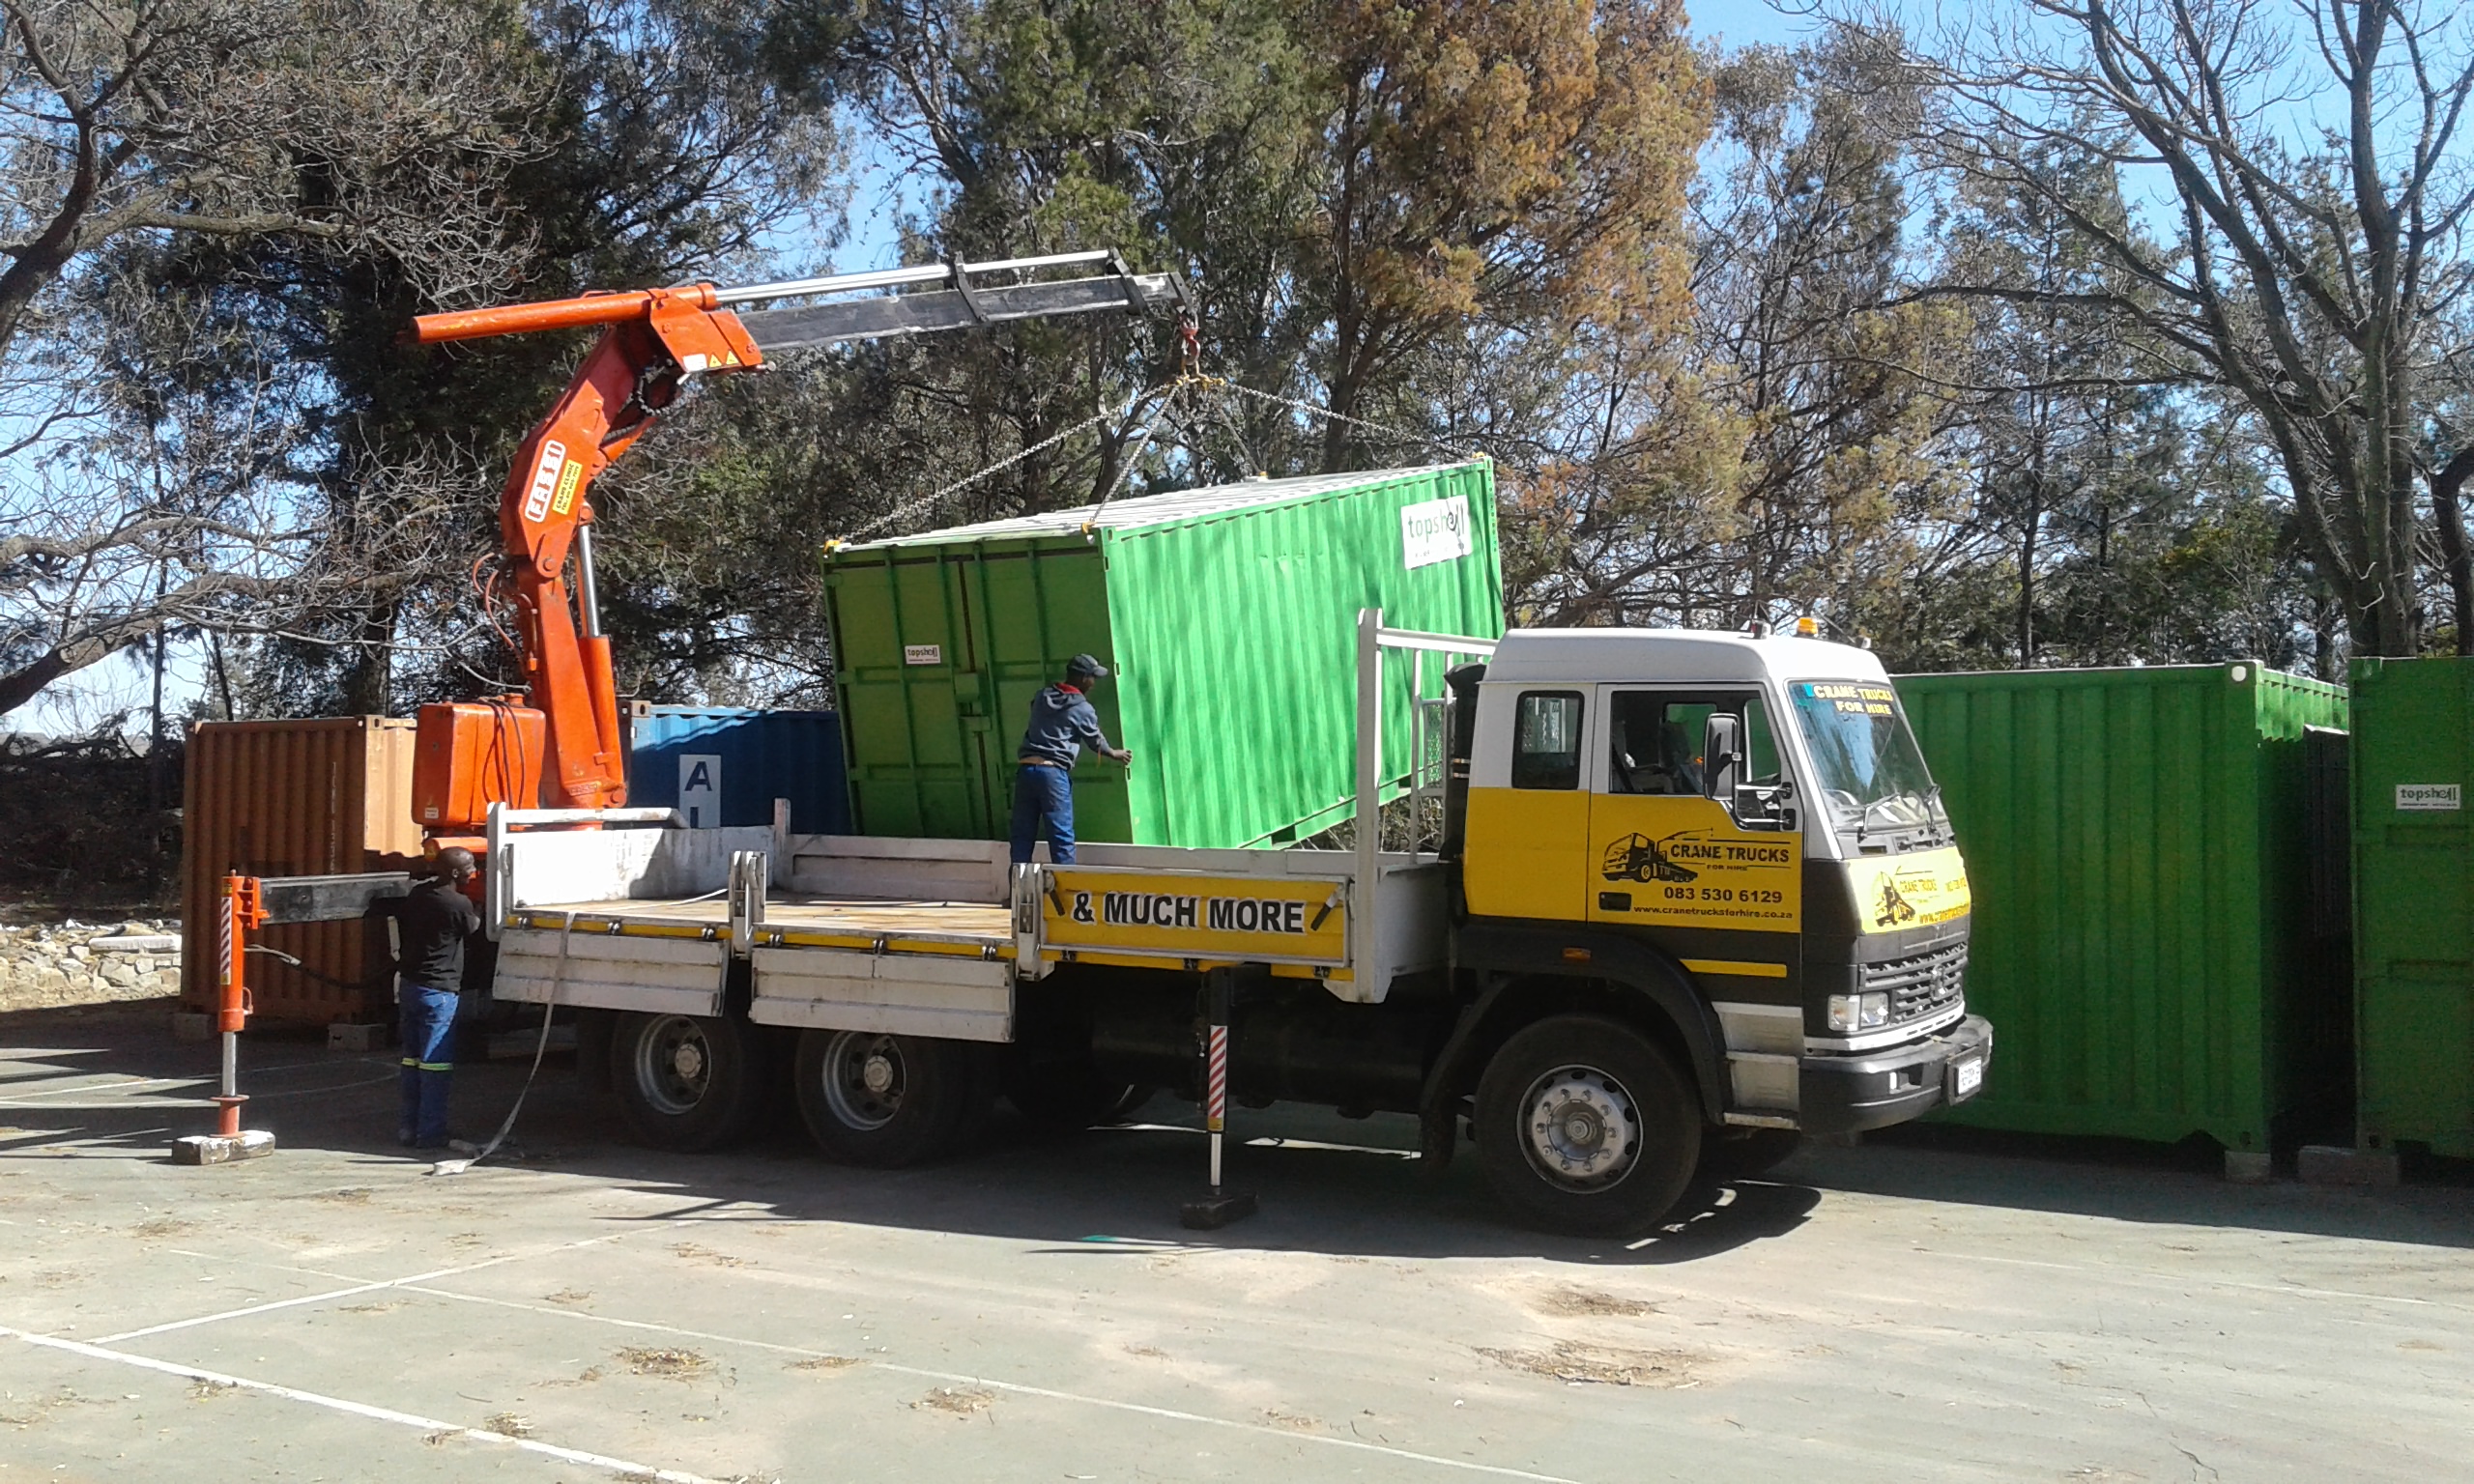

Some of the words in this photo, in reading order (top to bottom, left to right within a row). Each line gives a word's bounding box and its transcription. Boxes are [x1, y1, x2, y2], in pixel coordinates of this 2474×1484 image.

[528, 443, 563, 518] FASSI
[1408, 501, 1465, 543] topshell
[1813, 686, 1858, 699] CRANE
[1857, 689, 1893, 701] TRUCKS
[1835, 700, 1864, 712] FOR
[1865, 703, 1892, 715] HIRE
[2401, 786, 2457, 801] topshell
[1670, 843, 1721, 860] CRANE
[1727, 846, 1790, 863] TRUCKS
[1663, 886, 1695, 900] 083
[1701, 888, 1733, 901] 530
[1739, 890, 1783, 903] 6129
[1073, 892, 1094, 923] &
[1105, 893, 1196, 928] MUCH
[1209, 899, 1305, 933] MORE
[1633, 904, 1793, 919] www.cranetrucksforhire.co.za
